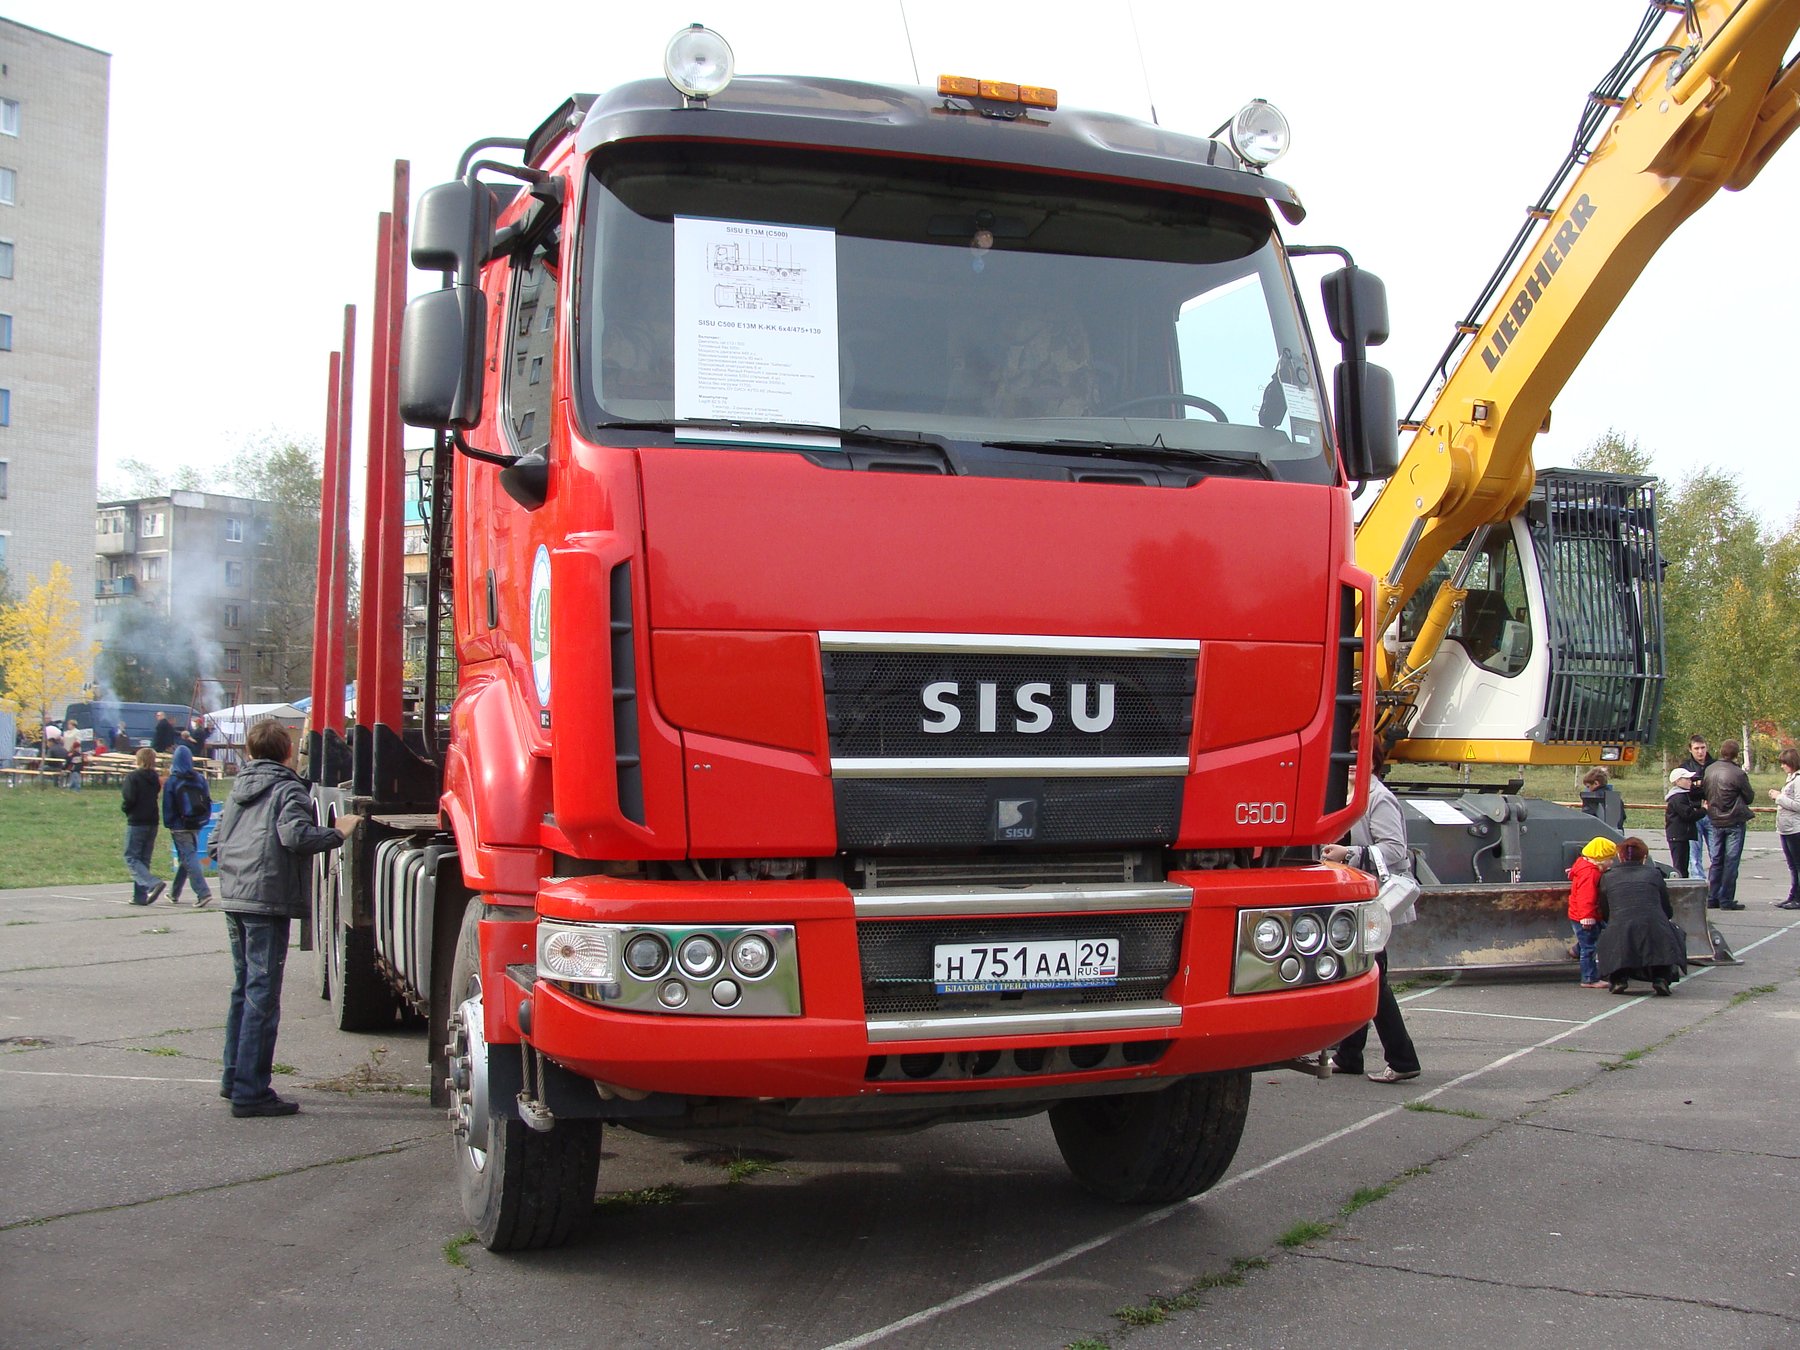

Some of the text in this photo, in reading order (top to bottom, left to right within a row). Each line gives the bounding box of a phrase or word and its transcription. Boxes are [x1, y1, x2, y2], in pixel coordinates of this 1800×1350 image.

[726, 226, 788, 239] SISU E13M (C500)
[1480, 193, 1598, 373] LIEBHERR
[698, 319, 716, 327] SISU
[717, 320, 736, 328] C500
[737, 322, 757, 330] E13M
[922, 681, 1115, 734] SISU
[1235, 801, 1287, 825] C500
[1005, 828, 1033, 838] SISU
[1080, 942, 1109, 967] 29
[1077, 966, 1099, 976] RUS
[945, 983, 997, 993] БЛАГОВЕСТ
